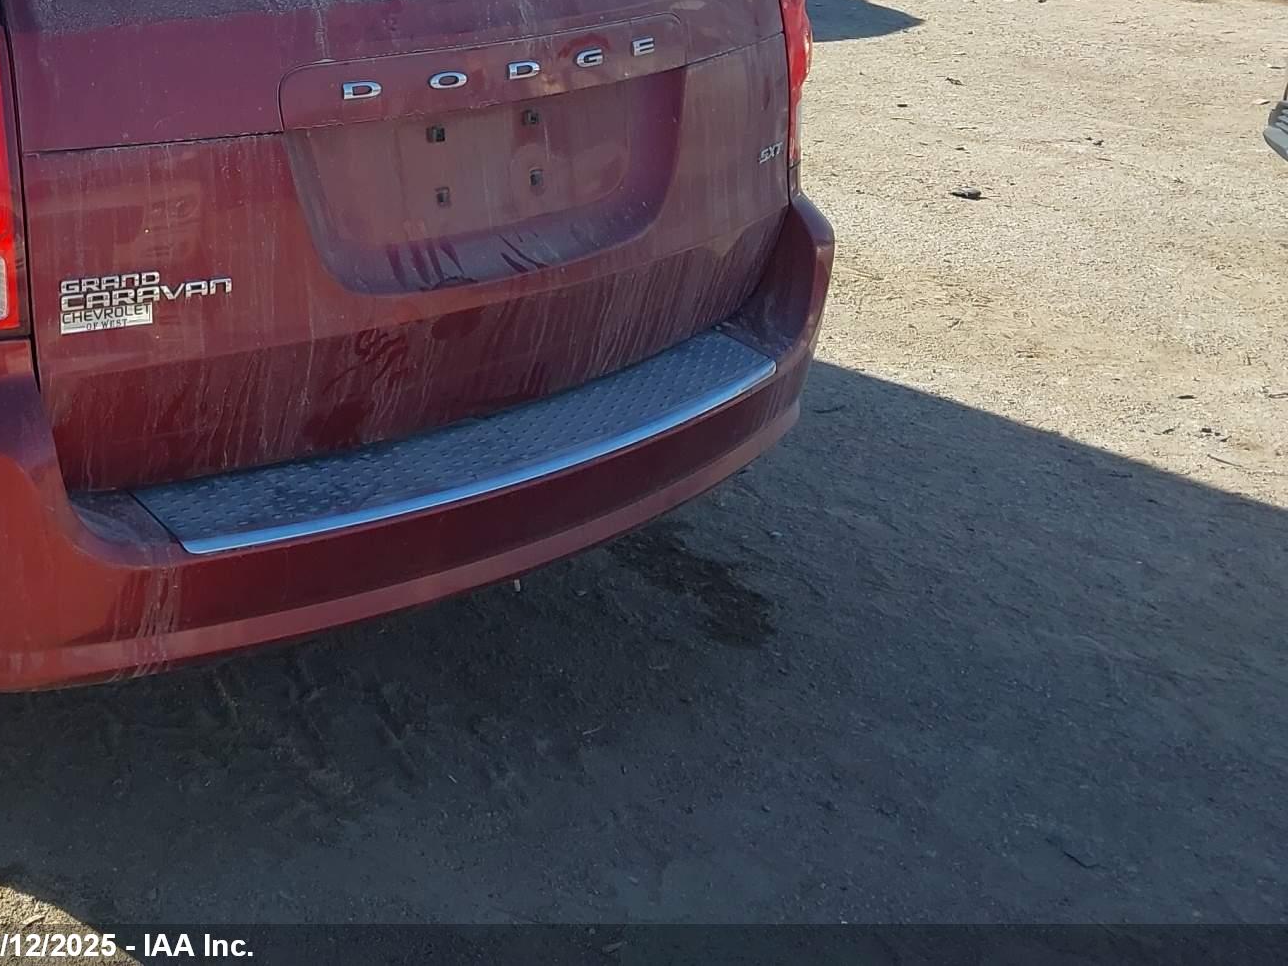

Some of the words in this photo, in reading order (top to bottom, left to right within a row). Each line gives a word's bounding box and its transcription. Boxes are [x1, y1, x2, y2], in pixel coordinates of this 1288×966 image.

[343, 37, 655, 100] DODGE
[60, 271, 160, 295] GRAND
[60, 278, 232, 312] CARAVAN
[62, 304, 150, 324] CHEVROLET
[101, 319, 128, 328] WEST
